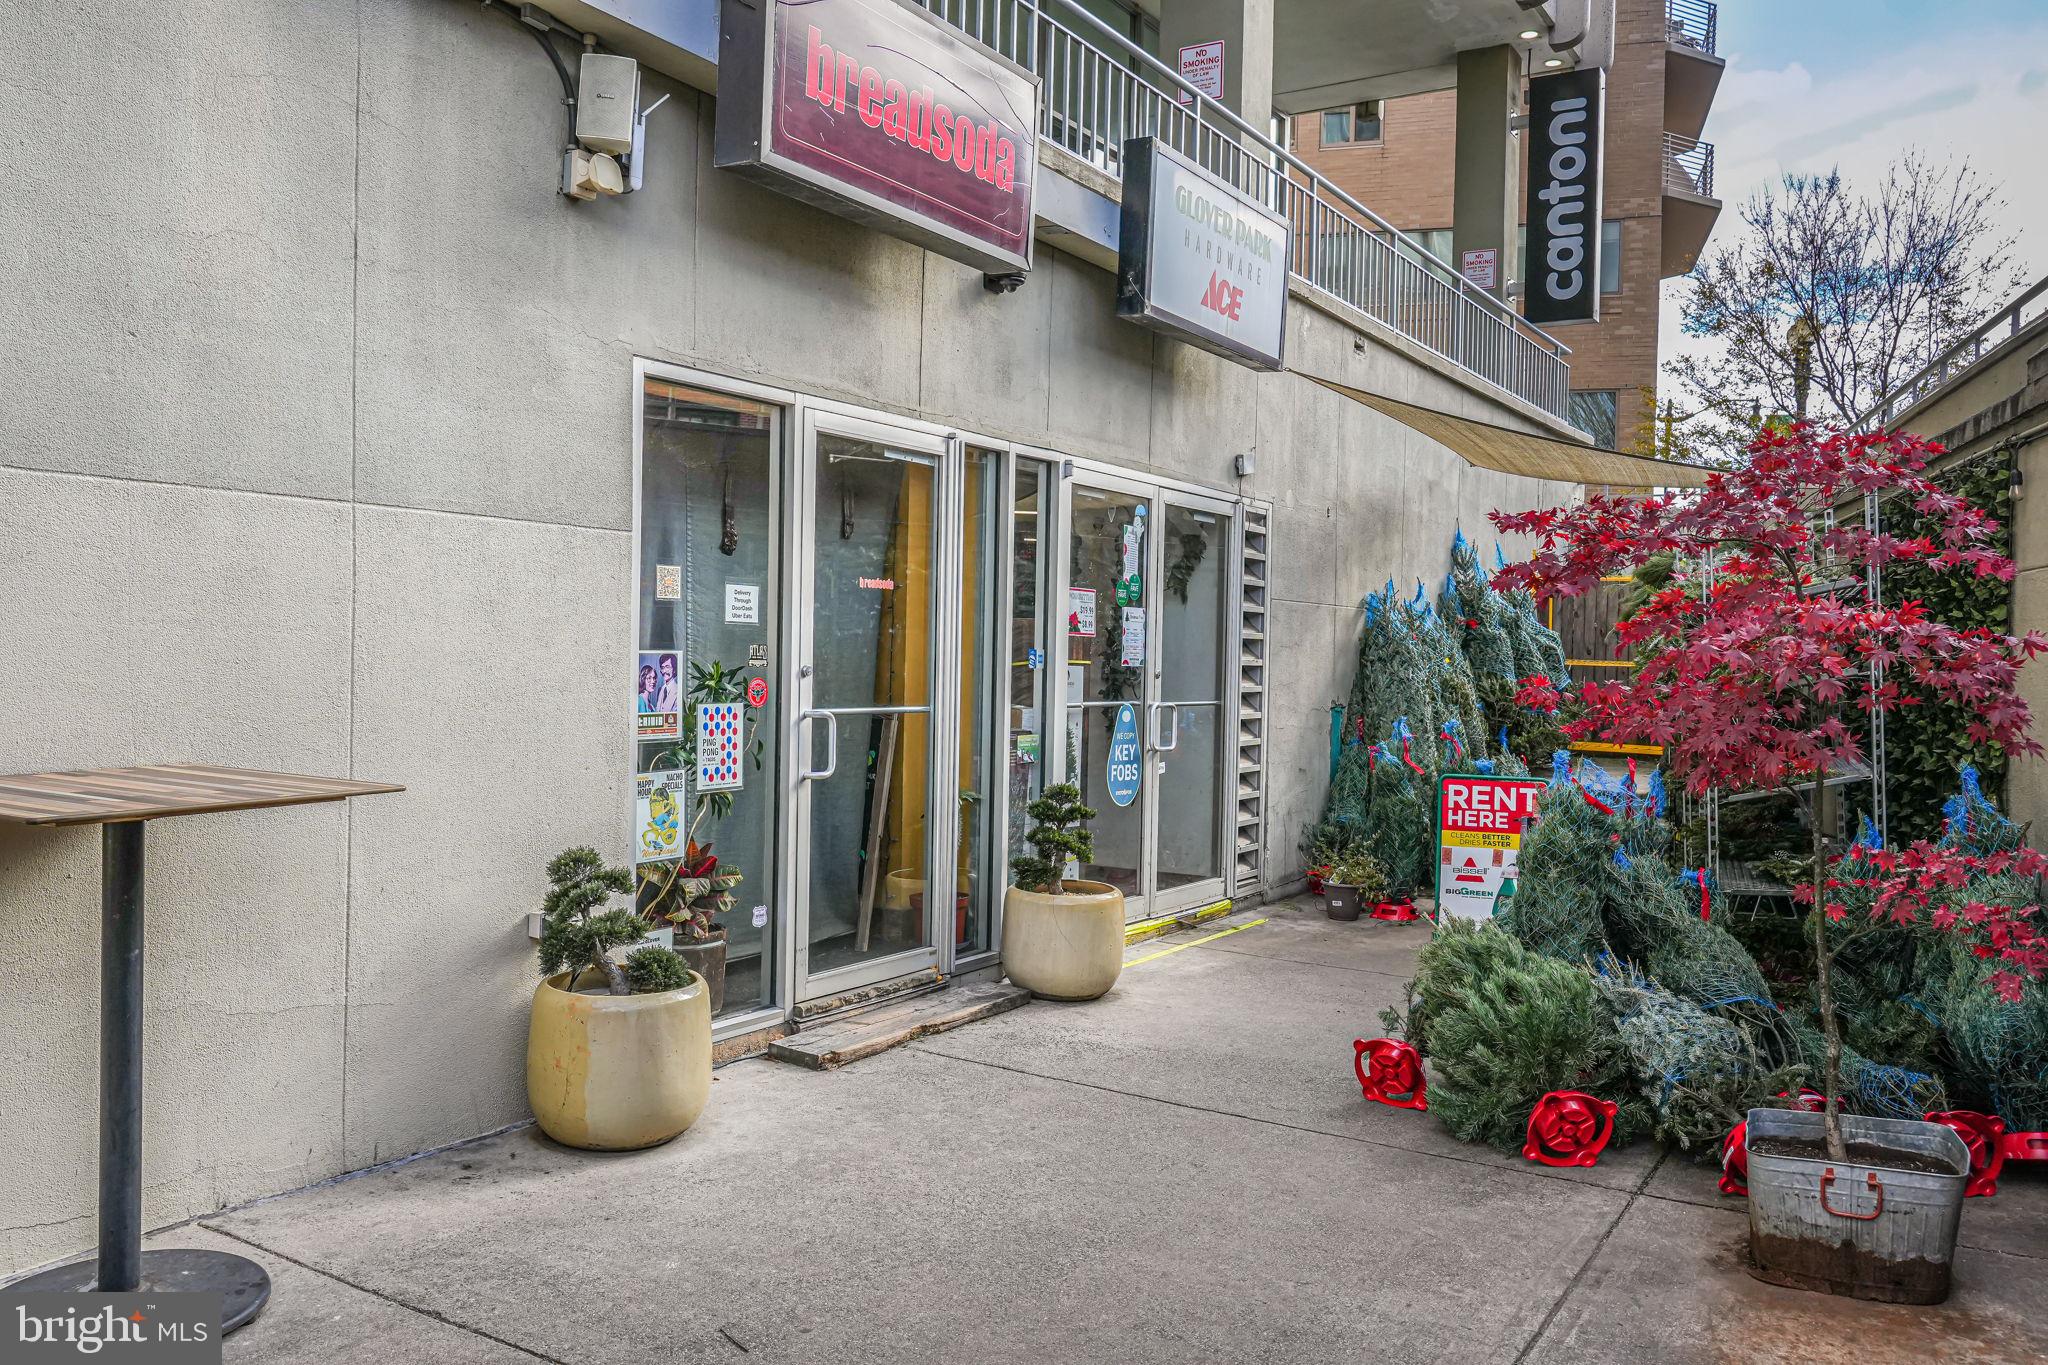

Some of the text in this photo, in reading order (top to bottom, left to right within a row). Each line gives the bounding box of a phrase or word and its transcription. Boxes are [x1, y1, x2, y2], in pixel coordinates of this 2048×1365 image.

[1195, 49, 1207, 58] NO
[1183, 56, 1220, 69] SMOKING
[806, 24, 1016, 194] breadsoda
[1538, 97, 1587, 301] cantoni
[1175, 185, 1272, 263] GLOVER PARK
[1184, 228, 1262, 285] HARDWARE
[1466, 259, 1493, 267] SMOKING
[1200, 269, 1244, 321] ACE
[734, 589, 751, 597] Delivery
[1124, 732, 1136, 740] COPY
[702, 738, 717, 747] PING
[702, 747, 719, 757] PONG
[1115, 744, 1137, 761] KEY
[666, 772, 683, 782] NACHO
[1111, 763, 1138, 781] FOBS
[638, 779, 655, 789] HAPPY
[661, 781, 683, 791] SPECIALS
[638, 788, 652, 797] HOUR
[1448, 784, 1538, 813] RENT
[1448, 810, 1509, 829] HERE
[1450, 831, 1511, 841] CLEANS BETTER
[1459, 838, 1511, 848] DRIES FASTER
